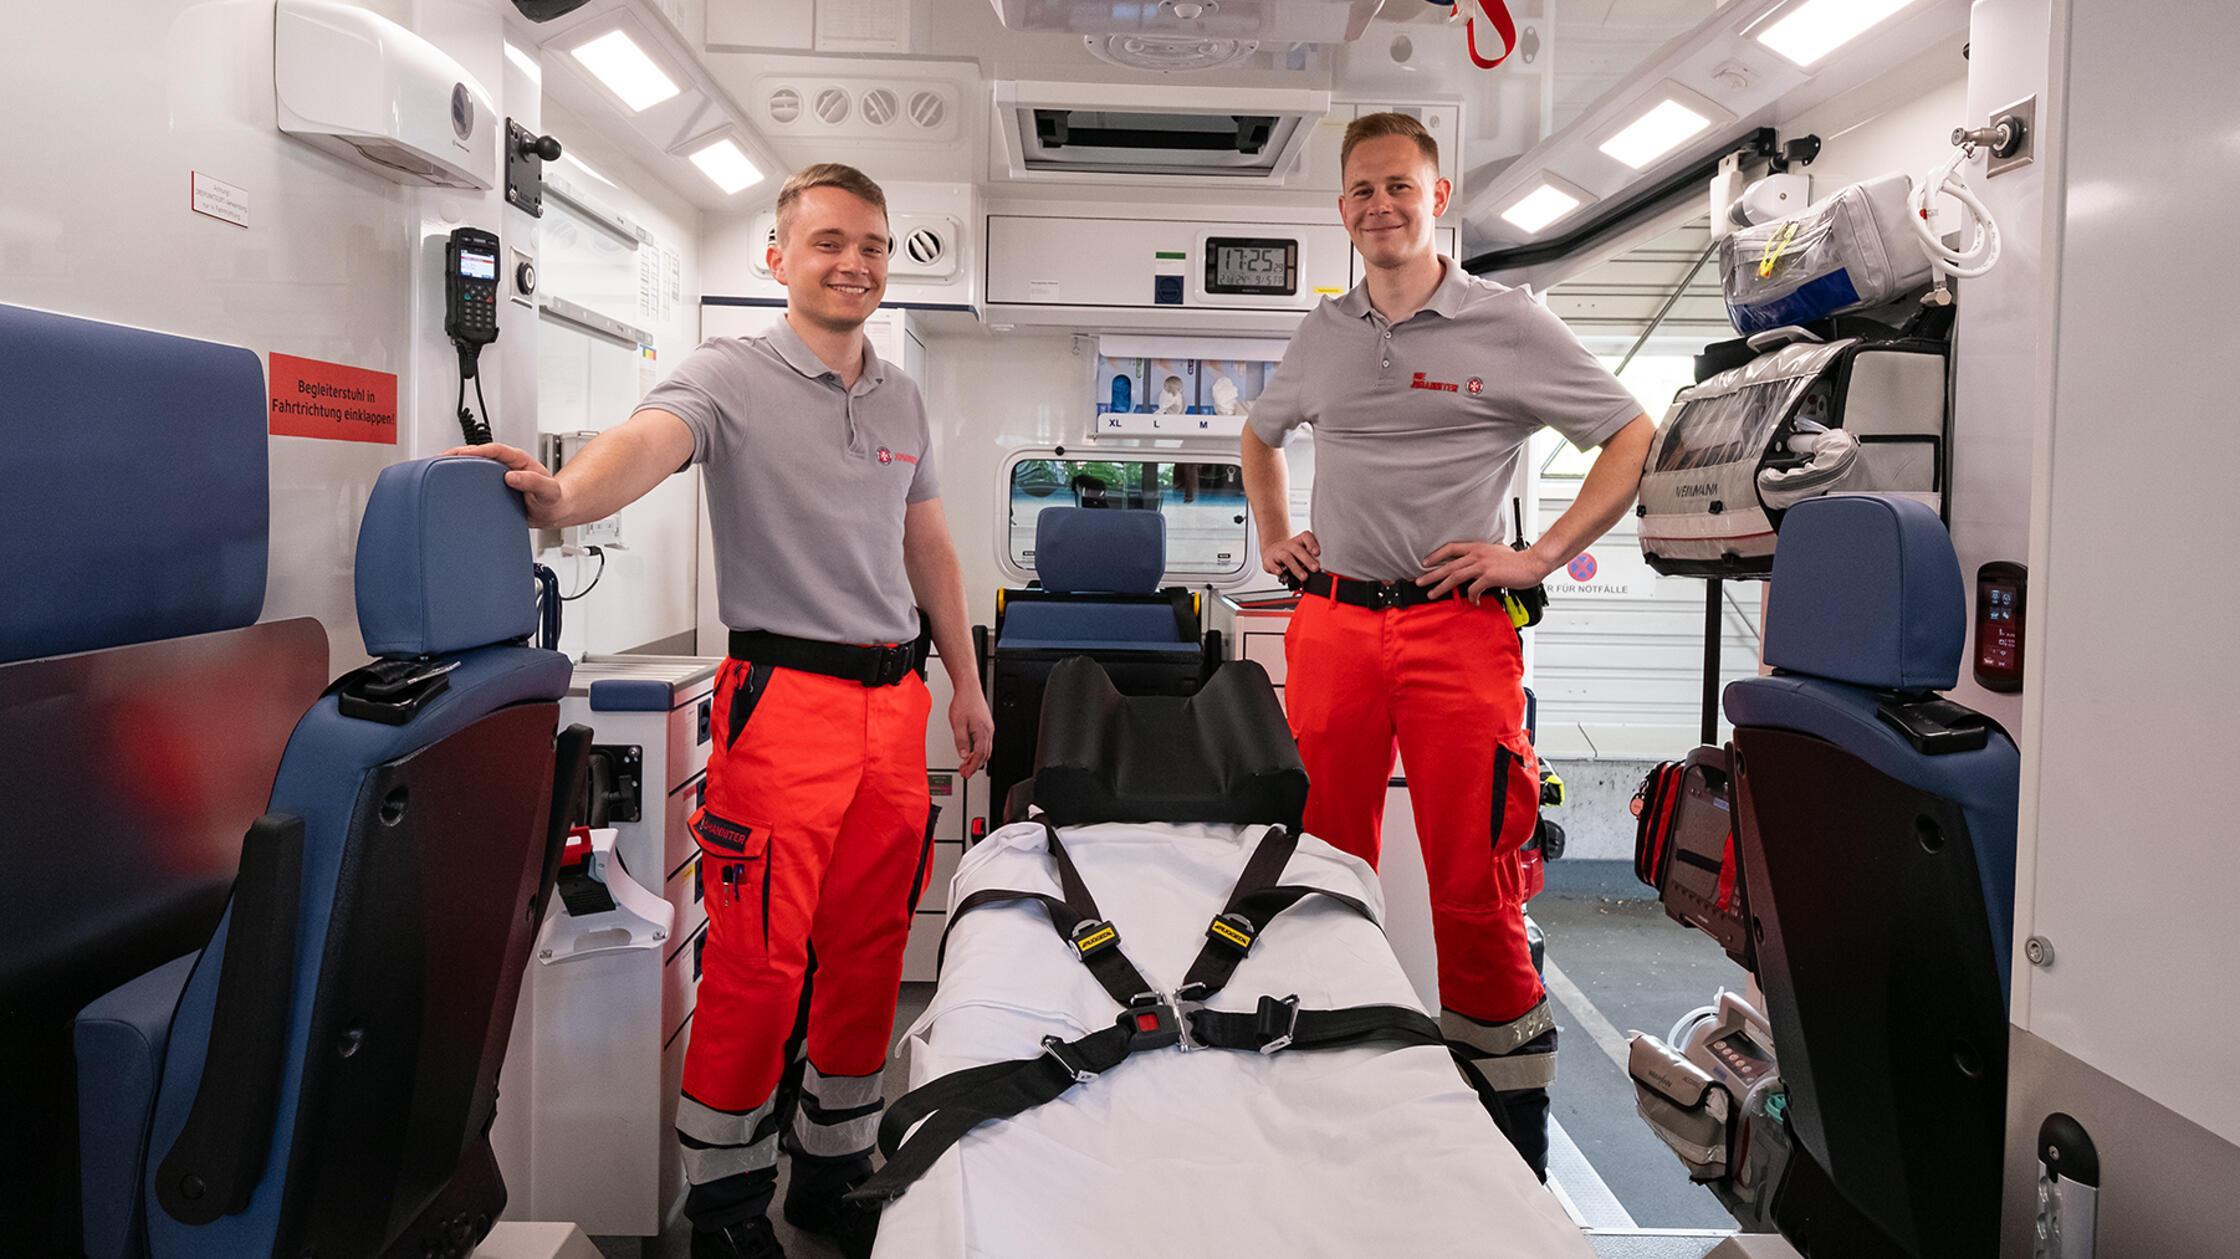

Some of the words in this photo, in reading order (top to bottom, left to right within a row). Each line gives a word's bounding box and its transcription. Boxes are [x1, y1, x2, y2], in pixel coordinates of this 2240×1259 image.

[1226, 249, 1273, 272] 17:25
[298, 380, 365, 402] Begleiterstuhl
[367, 390, 376, 403] in
[272, 398, 342, 423] Fahrtrichtung
[344, 408, 395, 426] einklappen!
[1109, 419, 1122, 427] XL
[1154, 420, 1160, 428] L
[1200, 421, 1208, 429] M
[1556, 583, 1576, 593] FÜR
[1578, 583, 1628, 594] NOTFÄLLE
